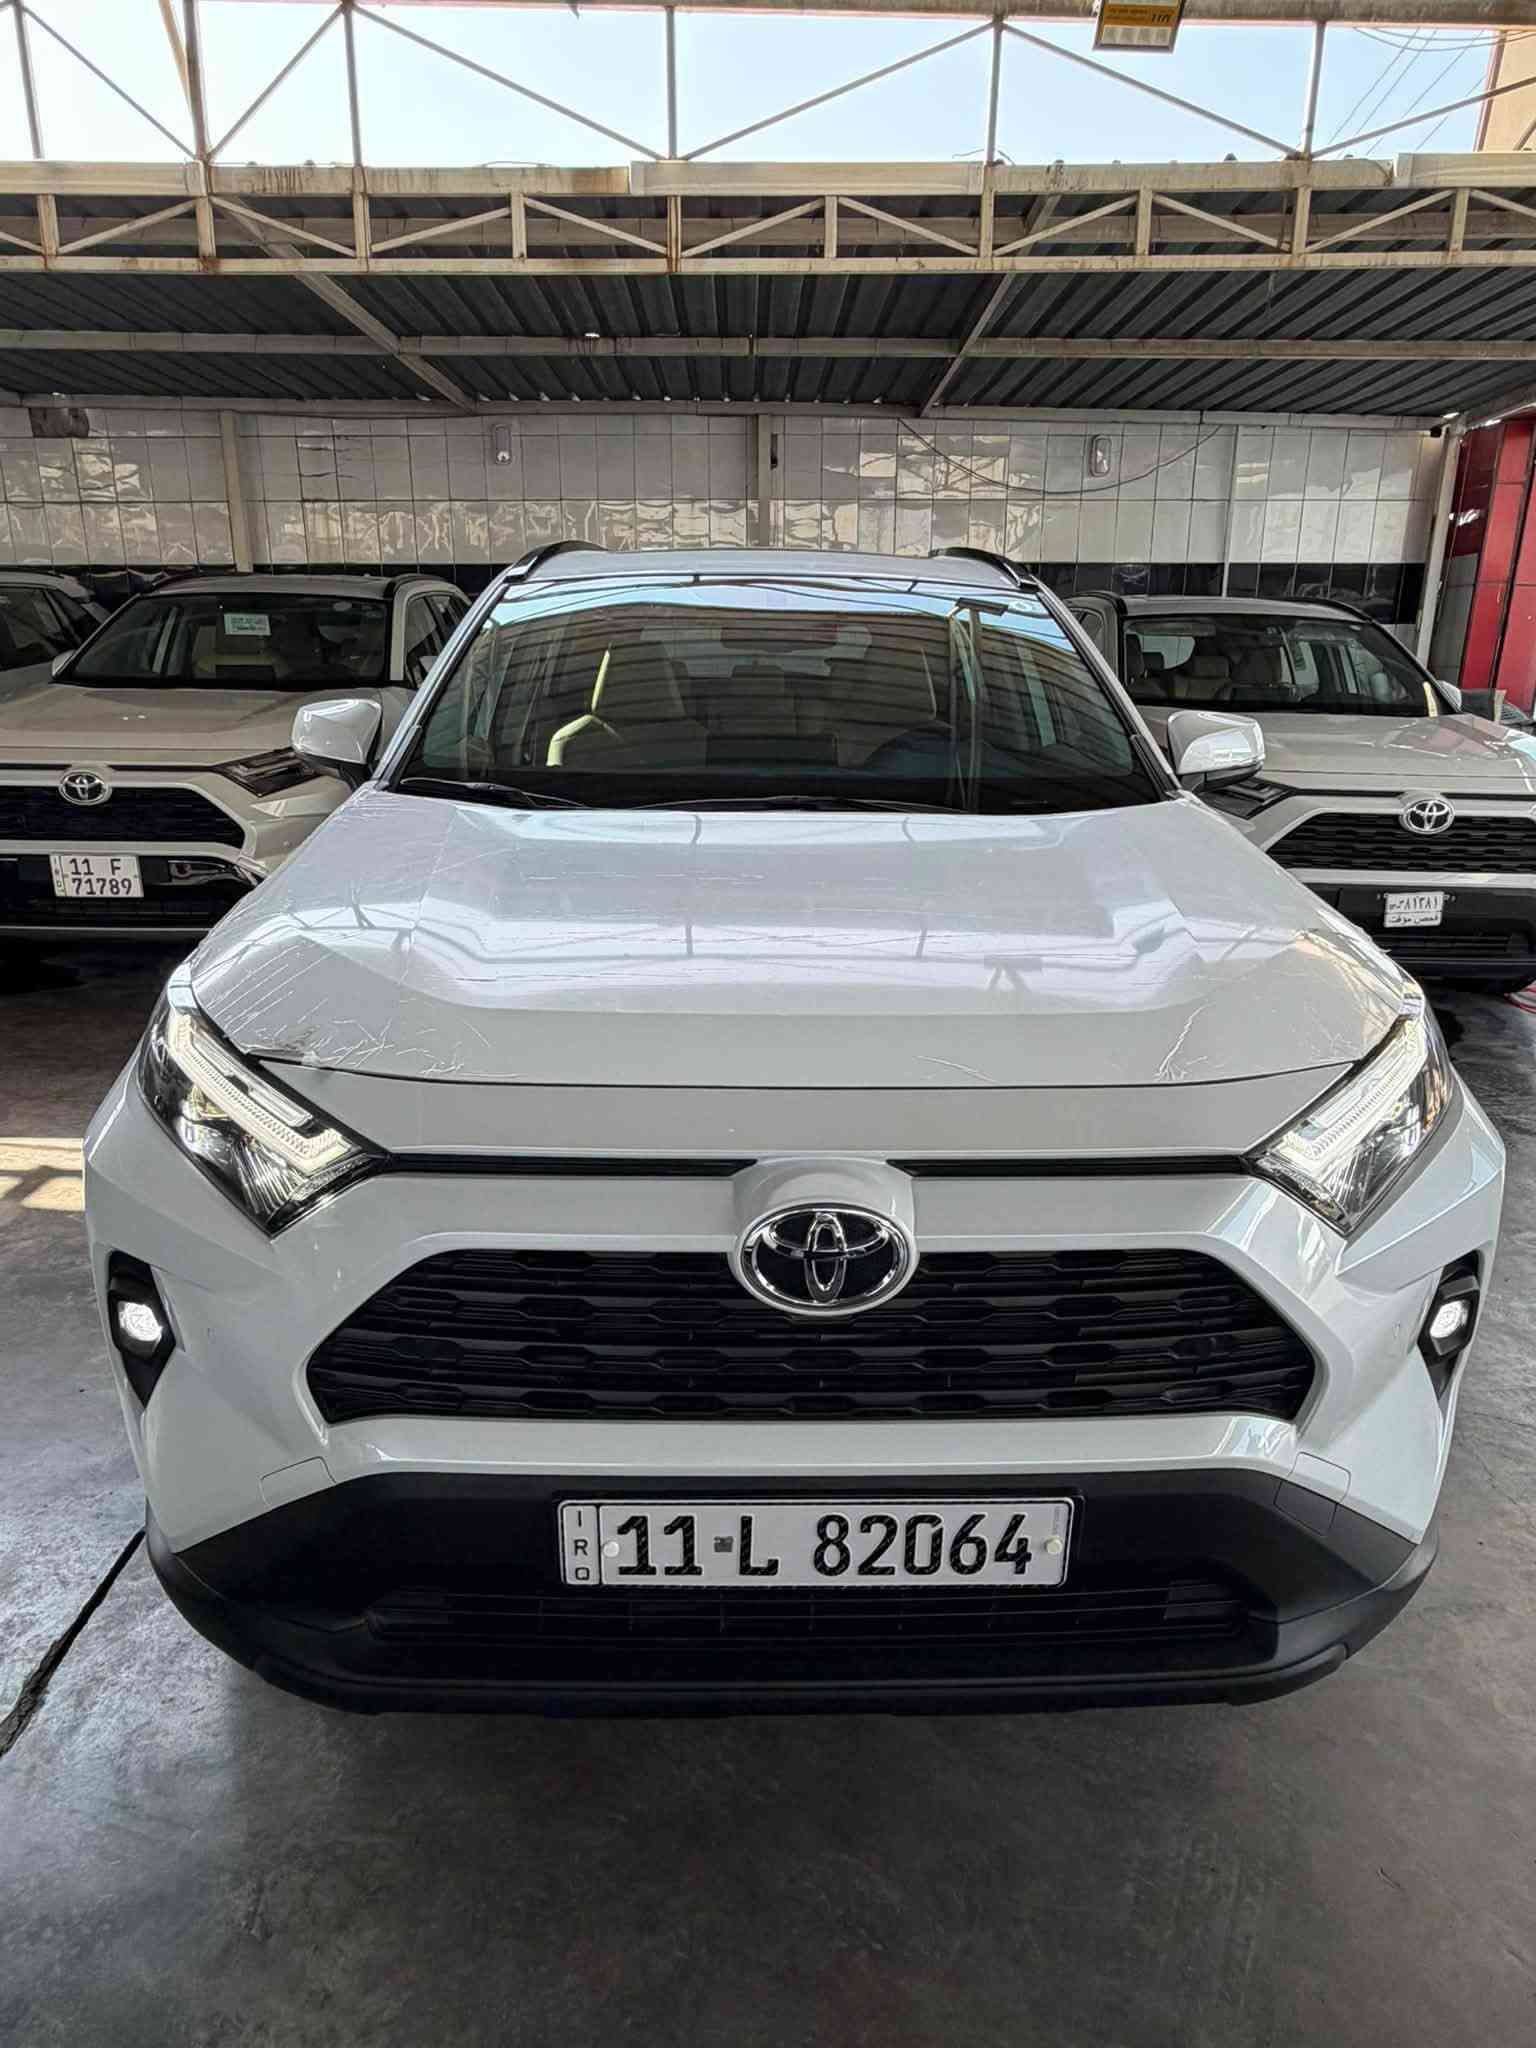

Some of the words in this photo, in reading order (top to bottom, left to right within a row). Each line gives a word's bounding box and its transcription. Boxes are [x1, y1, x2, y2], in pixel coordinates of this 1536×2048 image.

[70, 858, 94, 876] 11
[110, 858, 121, 876] F
[72, 878, 132, 896] 71789
[616, 1515, 703, 1576] 11
[738, 1516, 779, 1576] L
[812, 1513, 1033, 1577] 82064
